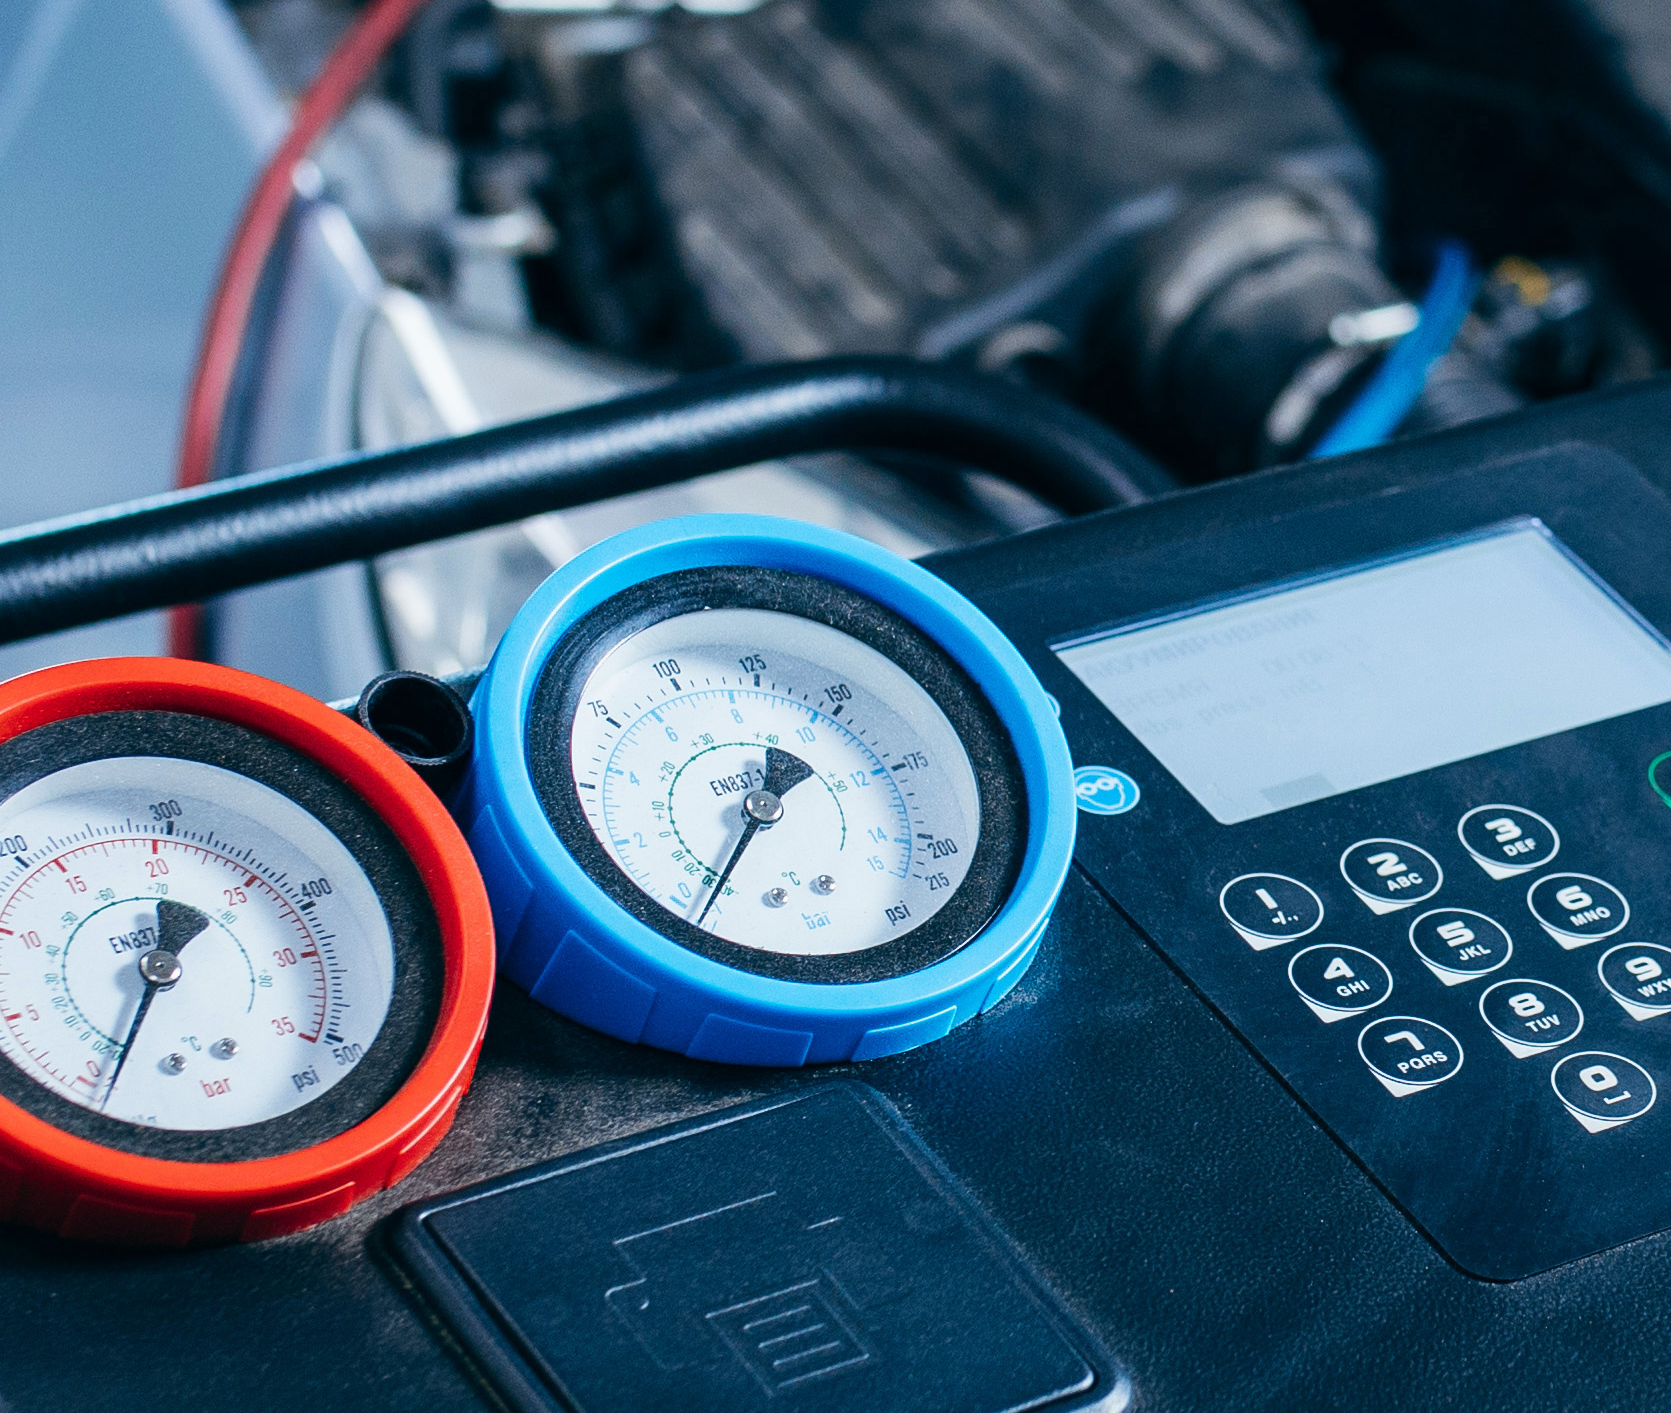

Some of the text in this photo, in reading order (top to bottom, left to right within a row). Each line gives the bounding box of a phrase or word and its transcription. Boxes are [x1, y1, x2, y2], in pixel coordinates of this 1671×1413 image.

[652, 658, 681, 679] 100
[738, 654, 767, 674] 125
[824, 683, 853, 704] 150
[588, 699, 609, 718] 75
[730, 708, 744, 724] 8
[665, 726, 679, 742] 6
[795, 726, 816, 744] 10
[902, 751, 929, 772] 175
[629, 770, 641, 786] 4
[849, 770, 871, 789] 12
[149, 799, 183, 822] 300
[633, 832, 648, 848] 2
[867, 827, 888, 844] 14
[1485, 817, 1522, 843] 3
[928, 838, 959, 859] 200
[1502, 838, 1537, 857] DEF
[145, 858, 169, 878] 20
[866, 855, 885, 873] 15
[1367, 851, 1408, 877] 2
[65, 875, 88, 895] 15
[300, 878, 333, 900] 400
[678, 882, 692, 899] 0
[925, 872, 951, 891] 215
[1386, 872, 1423, 892] ABC
[223, 886, 248, 907] 25
[1255, 888, 1278, 910] 1
[1556, 885, 1593, 911] 6
[884, 900, 912, 925] psi
[1569, 906, 1611, 927] MNO
[19, 930, 42, 950] 10
[1436, 920, 1475, 947] 5
[272, 948, 298, 969] 30
[1459, 944, 1492, 962] JKL
[1324, 957, 1355, 980] 4
[1625, 956, 1662, 982] 9
[1336, 980, 1371, 997] GHI
[25, 1004, 40, 1022] 5
[1508, 992, 1545, 1017] 8
[271, 1016, 296, 1036] 35
[1525, 1014, 1561, 1033] TUV
[79, 1031, 92, 1041] 0
[1384, 1030, 1425, 1052] 7
[332, 1043, 364, 1067] 500
[1397, 1051, 1448, 1074] PQRS
[86, 1060, 101, 1077] 0
[291, 1064, 321, 1093] psi
[1579, 1064, 1619, 1092] 0
[200, 1075, 232, 1099] bar
